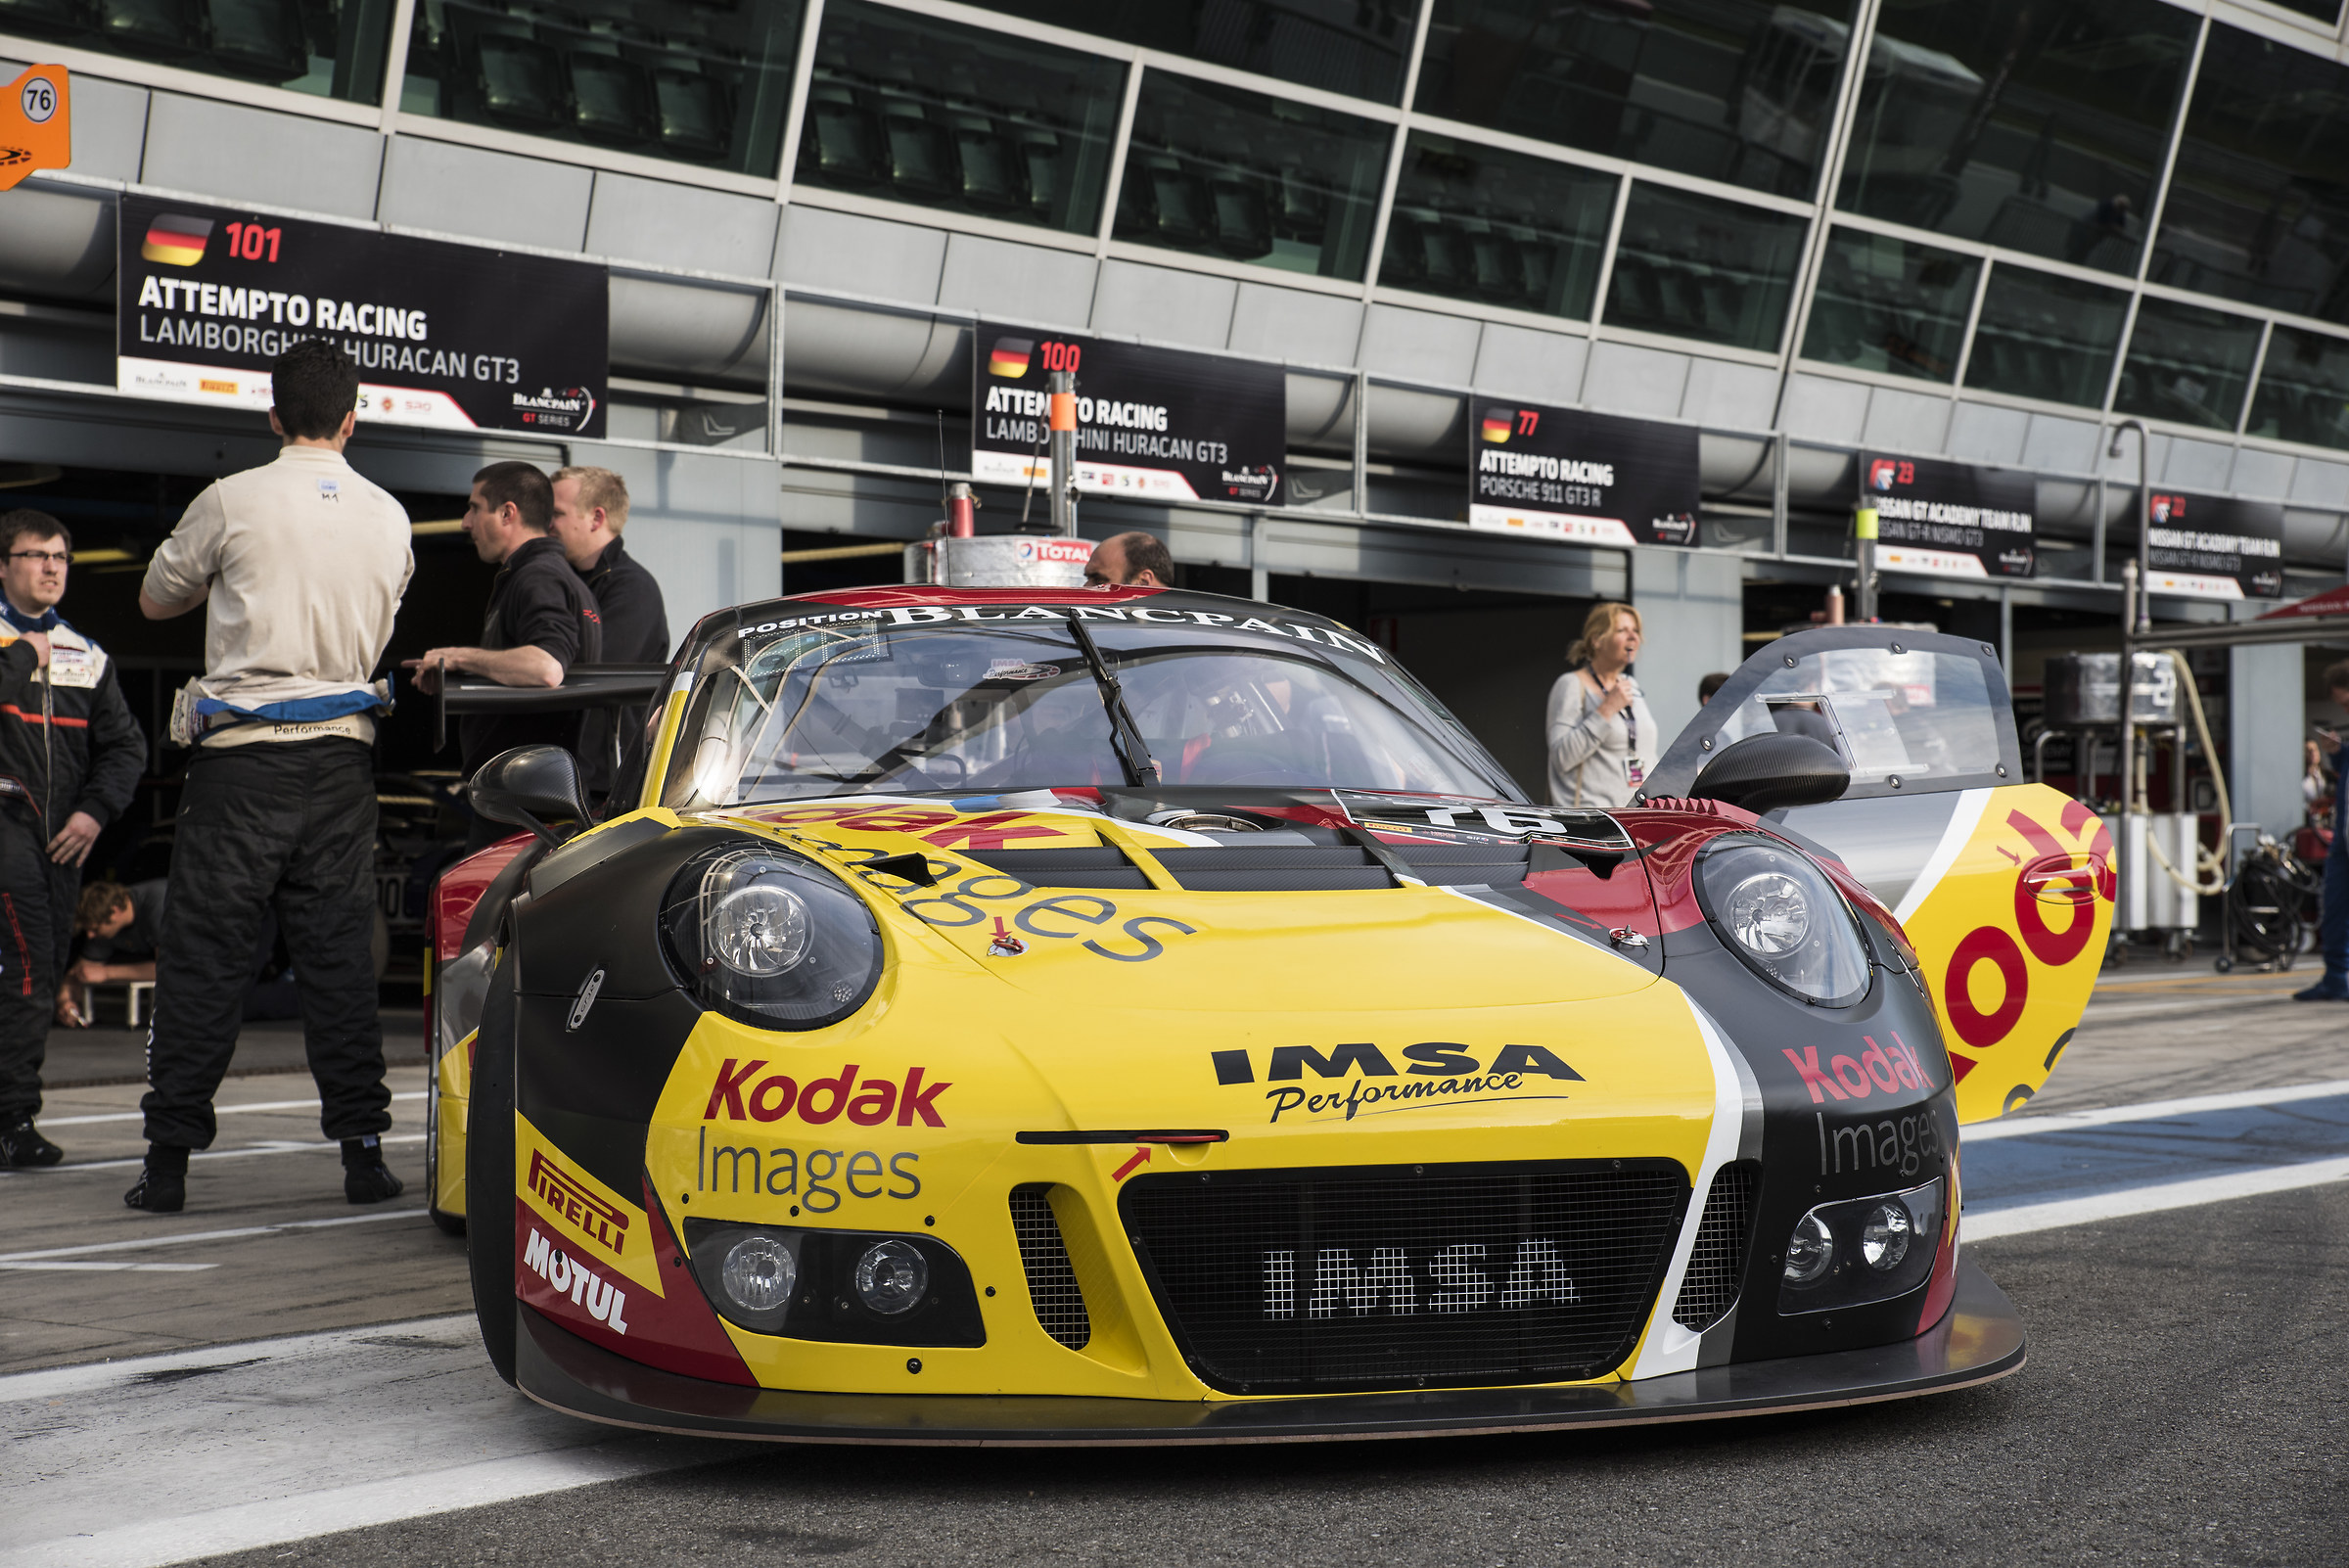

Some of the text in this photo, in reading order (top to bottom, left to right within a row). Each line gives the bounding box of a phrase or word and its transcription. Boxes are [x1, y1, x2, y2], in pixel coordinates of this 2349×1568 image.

[26, 89, 51, 111] 76
[225, 221, 282, 263] 101
[138, 275, 428, 342] ATTEMPTO RACING
[140, 314, 520, 385] LAMBORGH HURACAN GT3
[1040, 341, 1082, 373] 100
[513, 392, 581, 411] BLANCPAIN
[522, 411, 536, 423] GT
[986, 386, 1168, 432] ATTEMO RACING
[1518, 409, 1540, 437] 77
[987, 417, 1227, 465] LAMBOHINI HURACAN GT3
[1479, 449, 1614, 486] ATTEMPTO RACING
[1897, 461, 1914, 484] 23
[1479, 476, 1602, 507] PORSCHE 911 GT3 R
[1911, 500, 1929, 522] GT
[1928, 502, 1981, 528] ACADEMY
[1037, 541, 1091, 563] TOTAL
[738, 610, 883, 638] POSITION
[886, 606, 1387, 666] BLANCPAIN
[274, 722, 351, 735] Performance
[1211, 1042, 1587, 1086] IMSA
[1781, 1031, 1935, 1104] Kodak
[704, 1058, 954, 1128] Kodak
[1266, 1070, 1524, 1125] Performance
[1816, 1109, 1939, 1176] Images
[698, 1126, 921, 1214] Images
[528, 1147, 629, 1256] PIRELLI
[524, 1226, 628, 1336] MOTUL
[1263, 1238, 1581, 1321] IMSA
